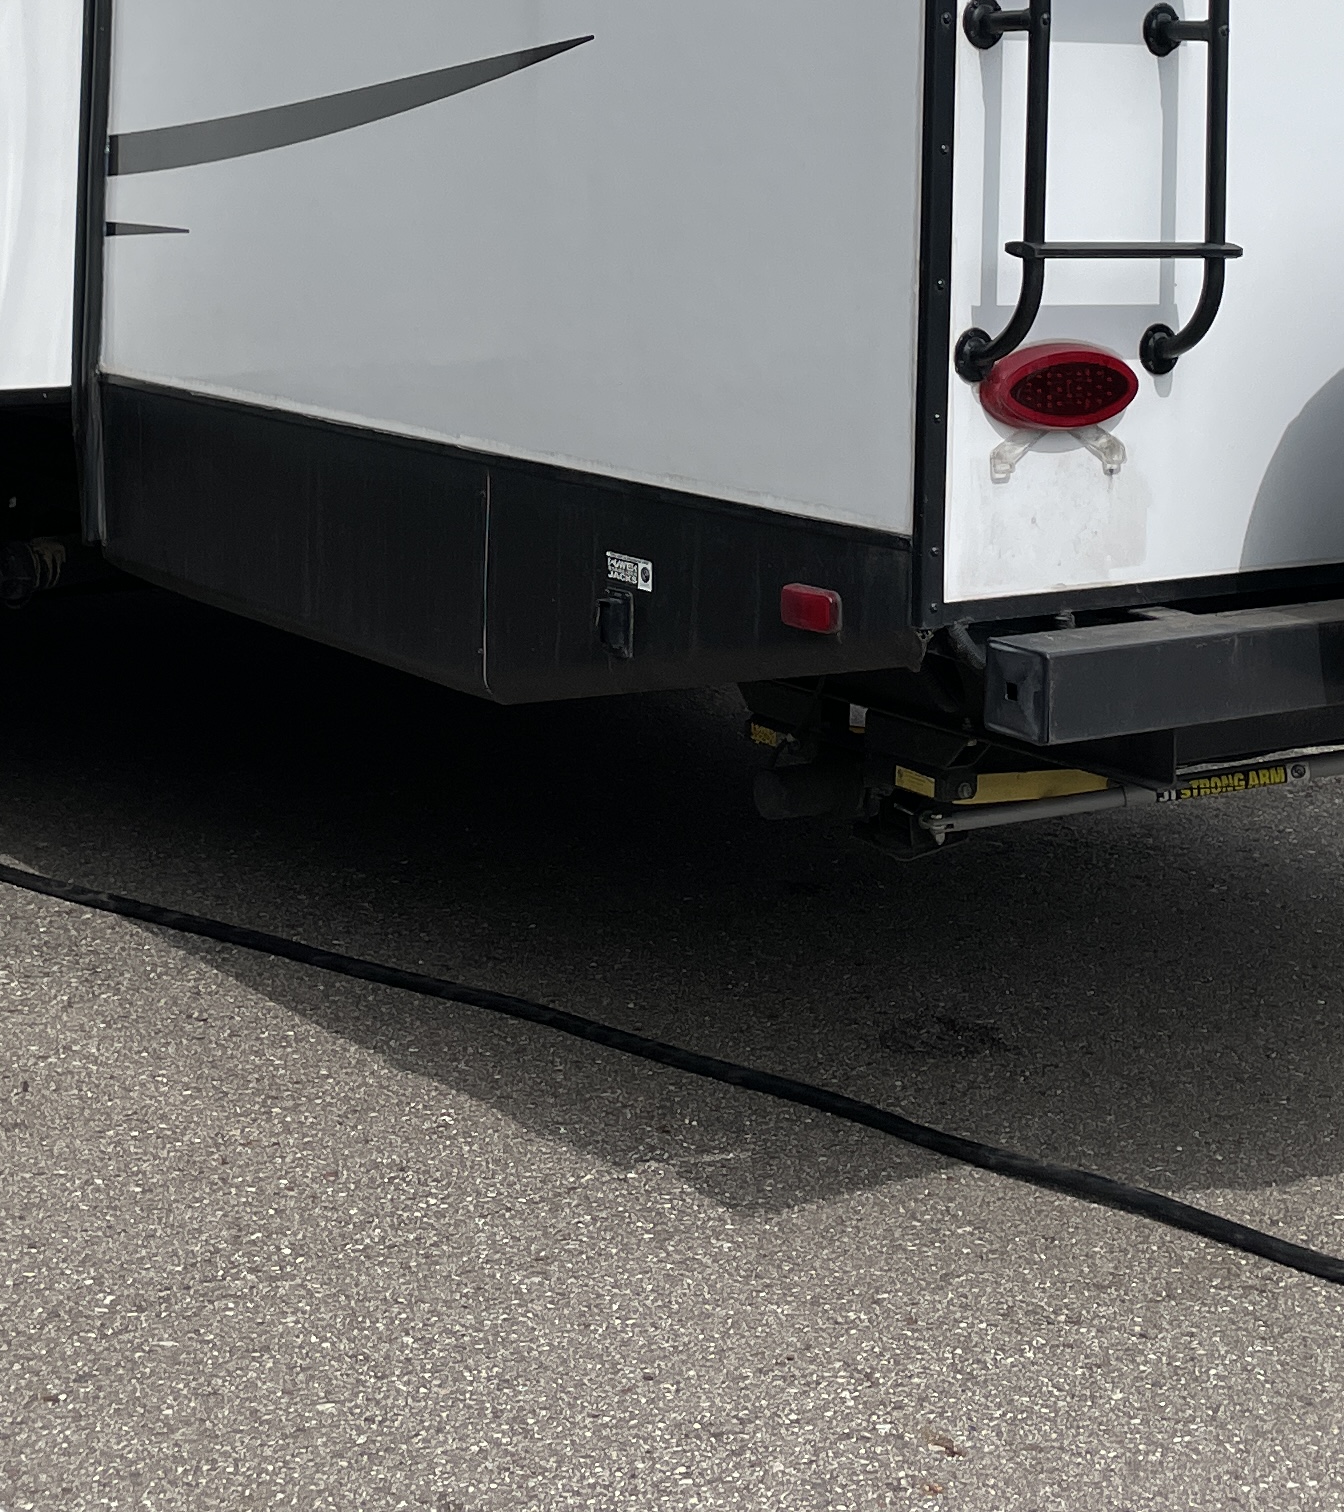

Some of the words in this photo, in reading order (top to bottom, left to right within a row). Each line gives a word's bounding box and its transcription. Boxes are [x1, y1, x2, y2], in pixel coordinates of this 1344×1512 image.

[607, 570, 638, 584] JACKS
[1180, 773, 1246, 799] STRONG
[1247, 766, 1286, 789] ARM
